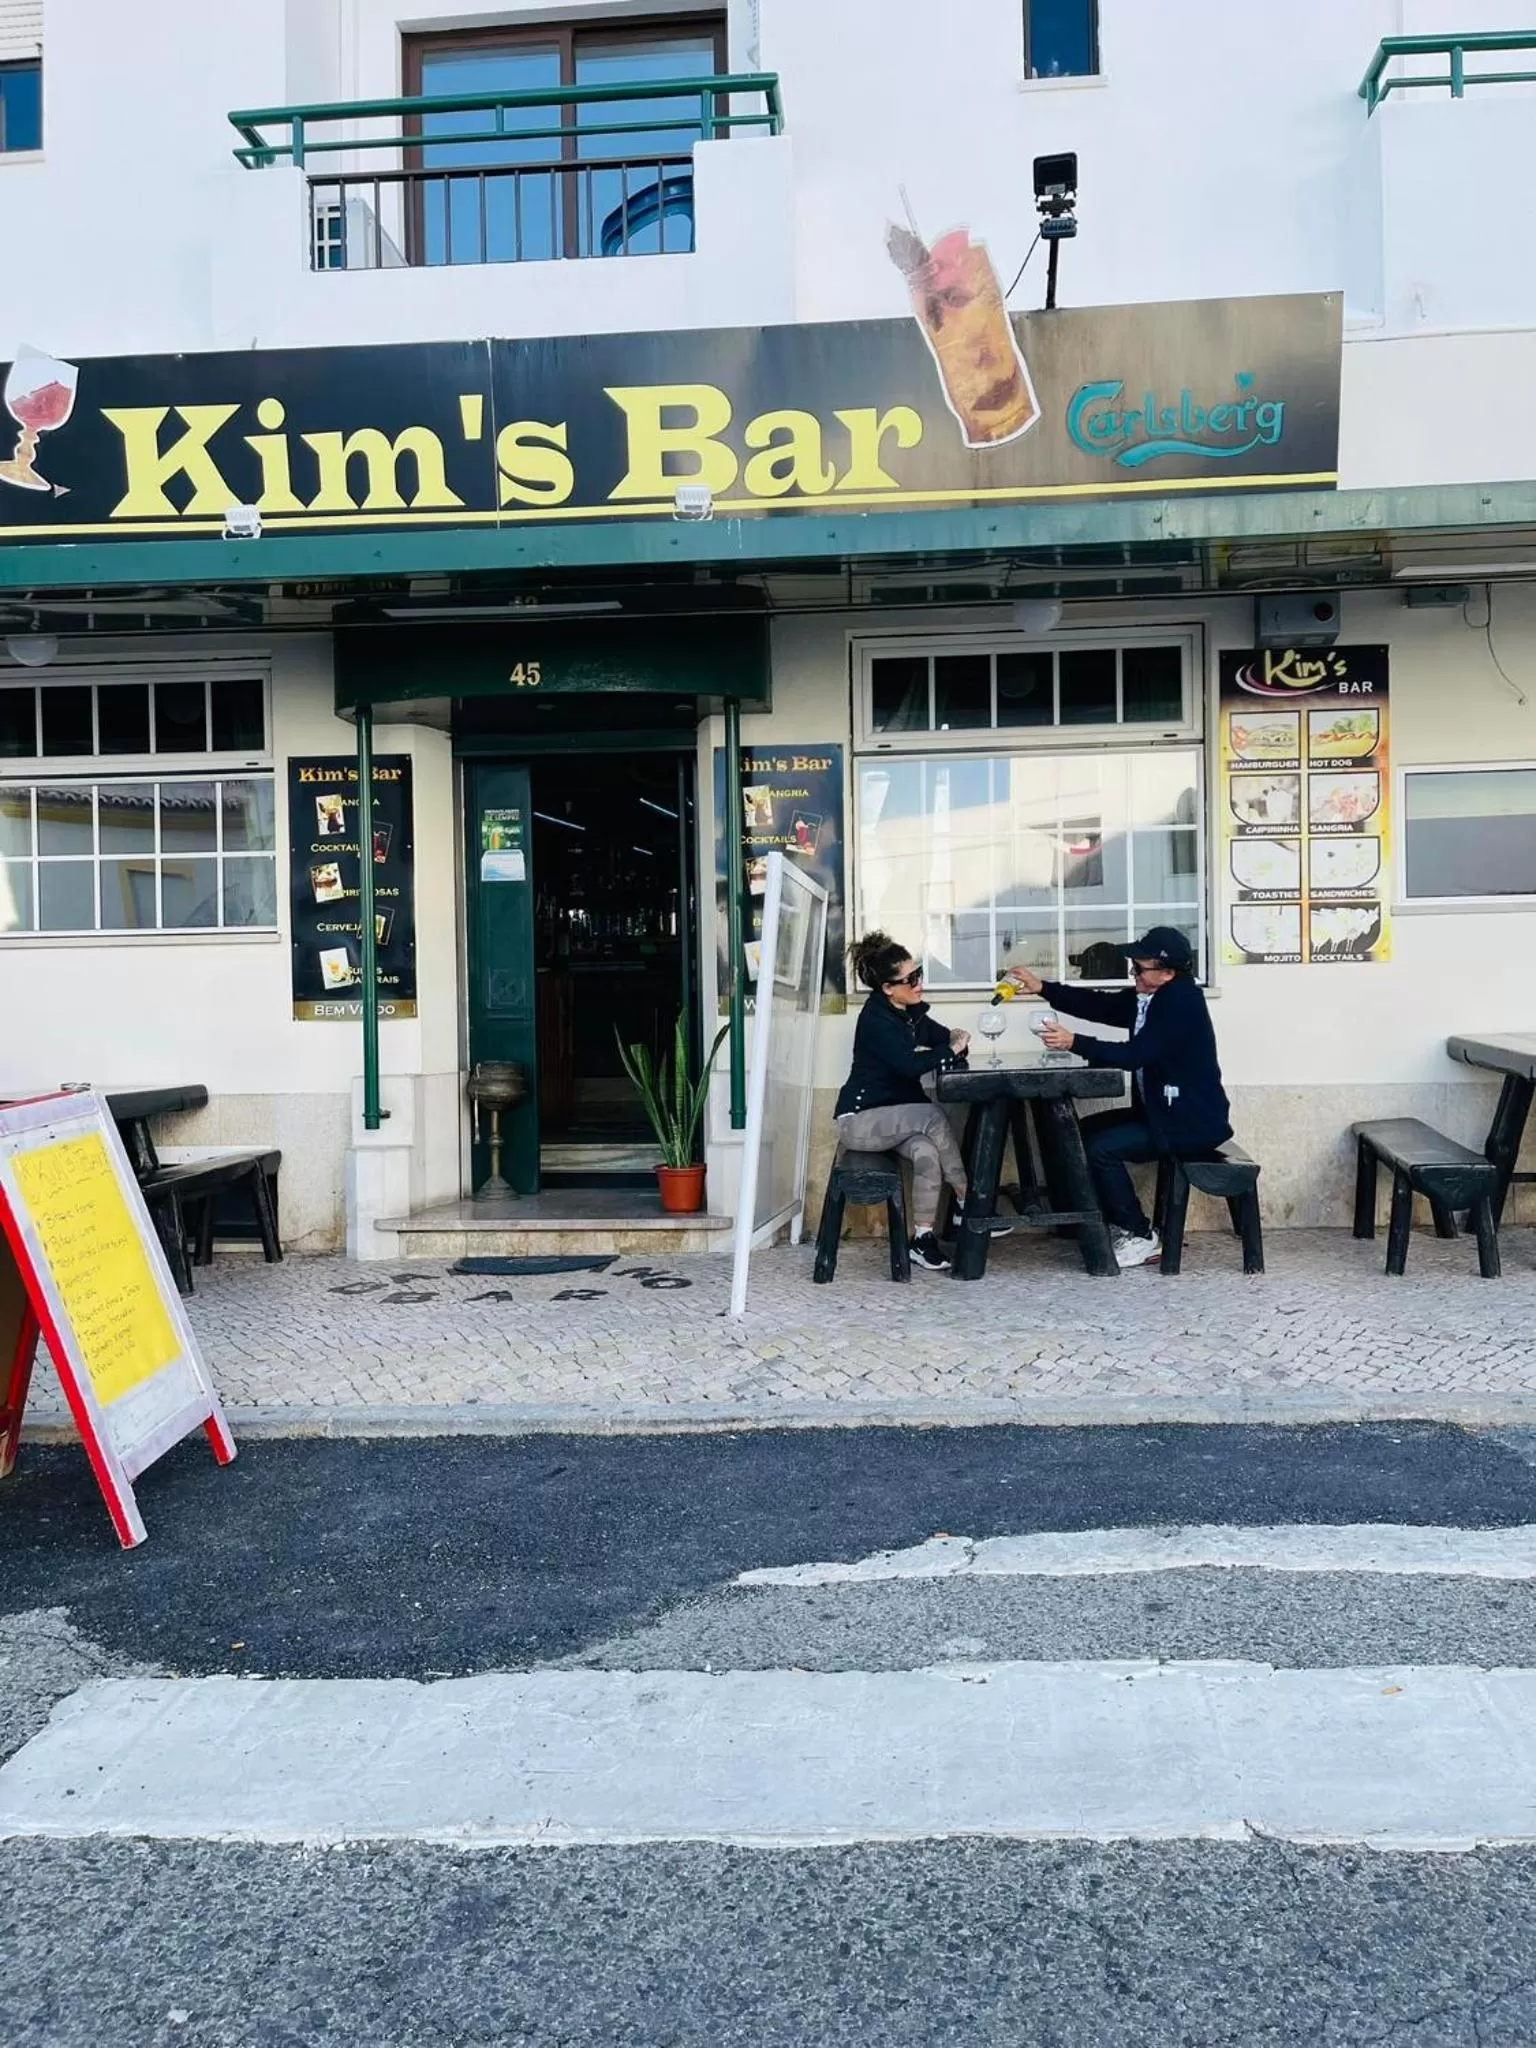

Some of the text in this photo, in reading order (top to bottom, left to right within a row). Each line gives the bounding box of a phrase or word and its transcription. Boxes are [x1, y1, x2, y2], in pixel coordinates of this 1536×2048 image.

[1066, 379, 1286, 464] Carlsberg
[99, 384, 924, 516] Kim's Bar
[509, 661, 541, 686] 45
[1264, 649, 1347, 687] Kim's
[1338, 681, 1374, 694] BAR
[740, 755, 832, 772] im's Bar
[1230, 761, 1299, 770] HAMBURGUER
[1308, 758, 1353, 769] HOT DOG
[299, 765, 359, 782] Kim's
[1245, 825, 1300, 834] CAIPIRINHA
[1310, 824, 1354, 832] SANGRIA
[1252, 891, 1301, 899] TOASTIES
[1310, 890, 1375, 898] SANDWICHES
[1263, 955, 1301, 963] MOJITO
[1310, 953, 1364, 962] COCKTAILS
[314, 1004, 346, 1016] BEM
